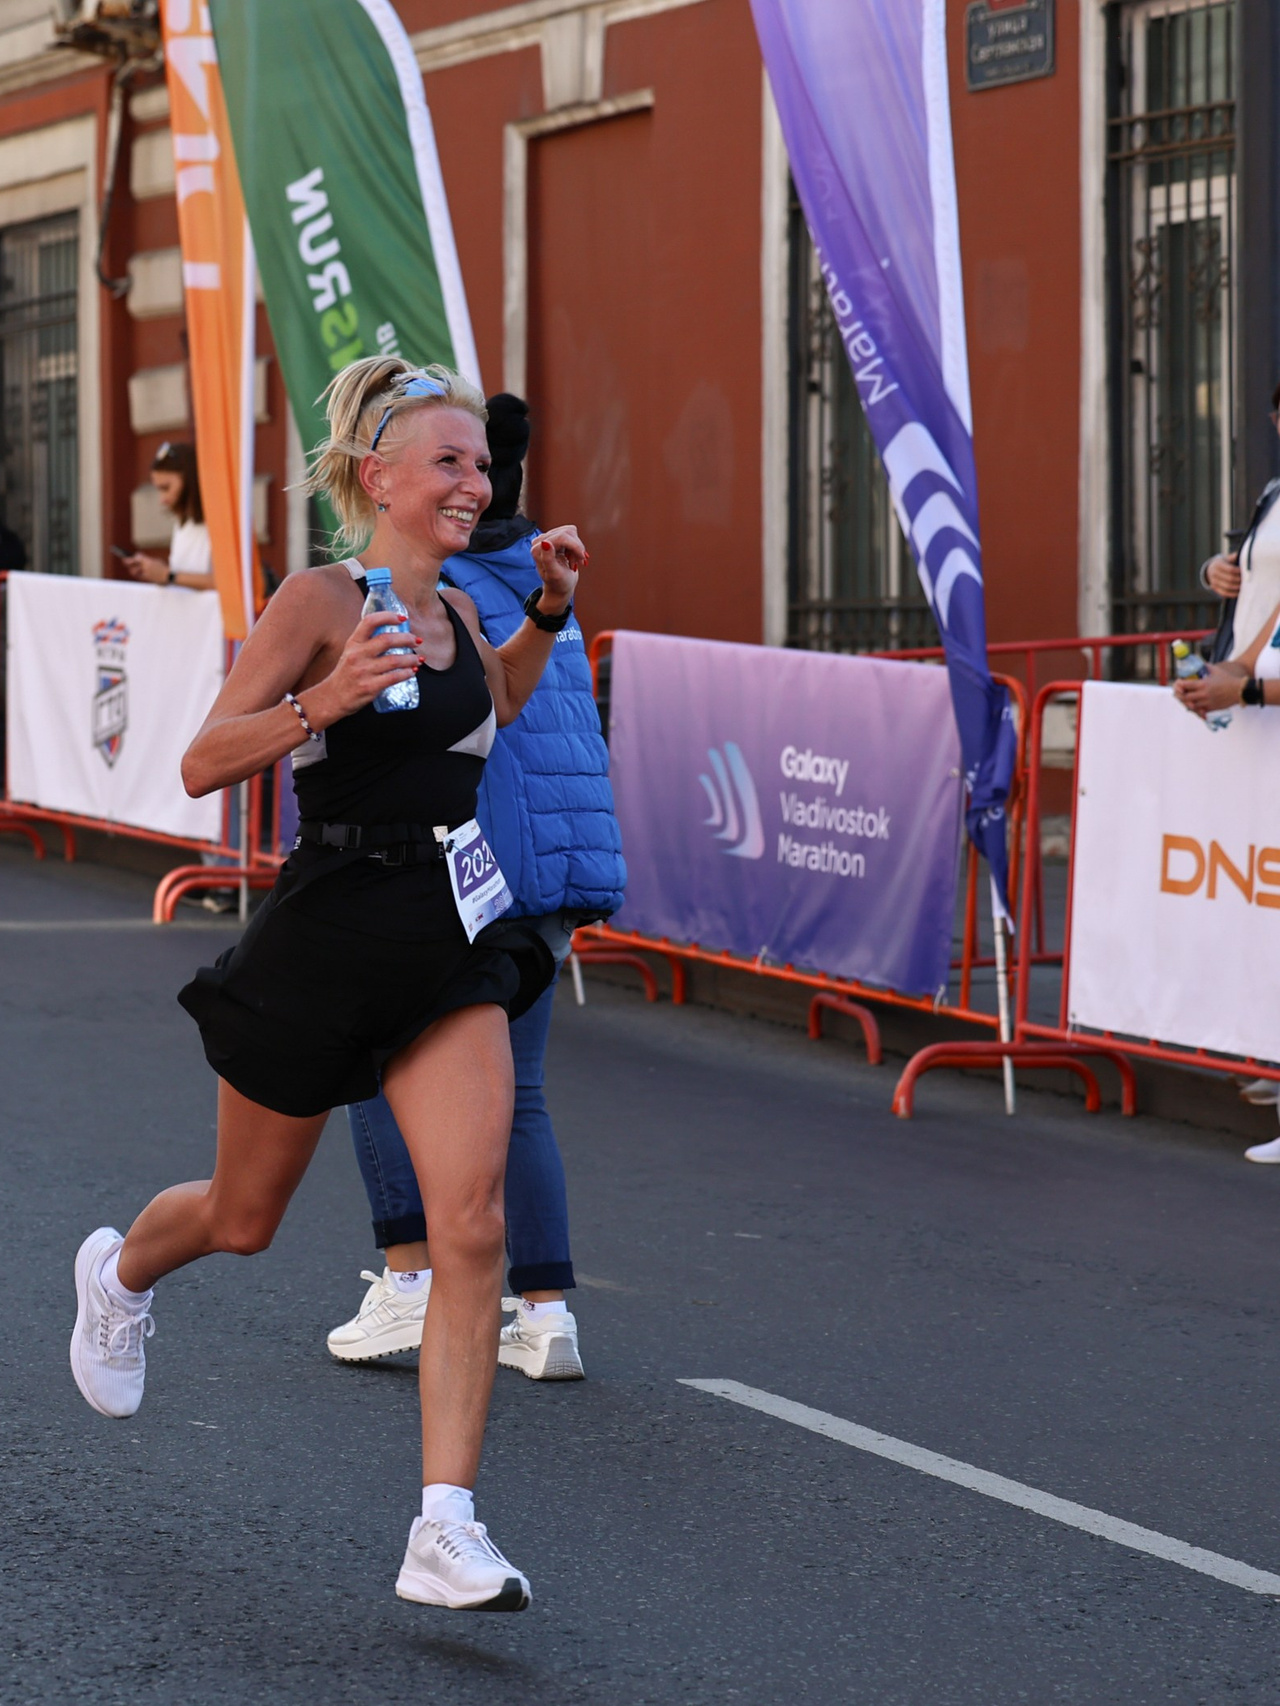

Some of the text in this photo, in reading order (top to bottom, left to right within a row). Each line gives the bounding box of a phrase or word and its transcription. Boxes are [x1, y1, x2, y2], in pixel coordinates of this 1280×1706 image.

[780, 745, 850, 797] Galaxy
[779, 791, 891, 840] Vladivostok
[777, 832, 865, 878] Marathon
[1160, 833, 1280, 909] DNS
